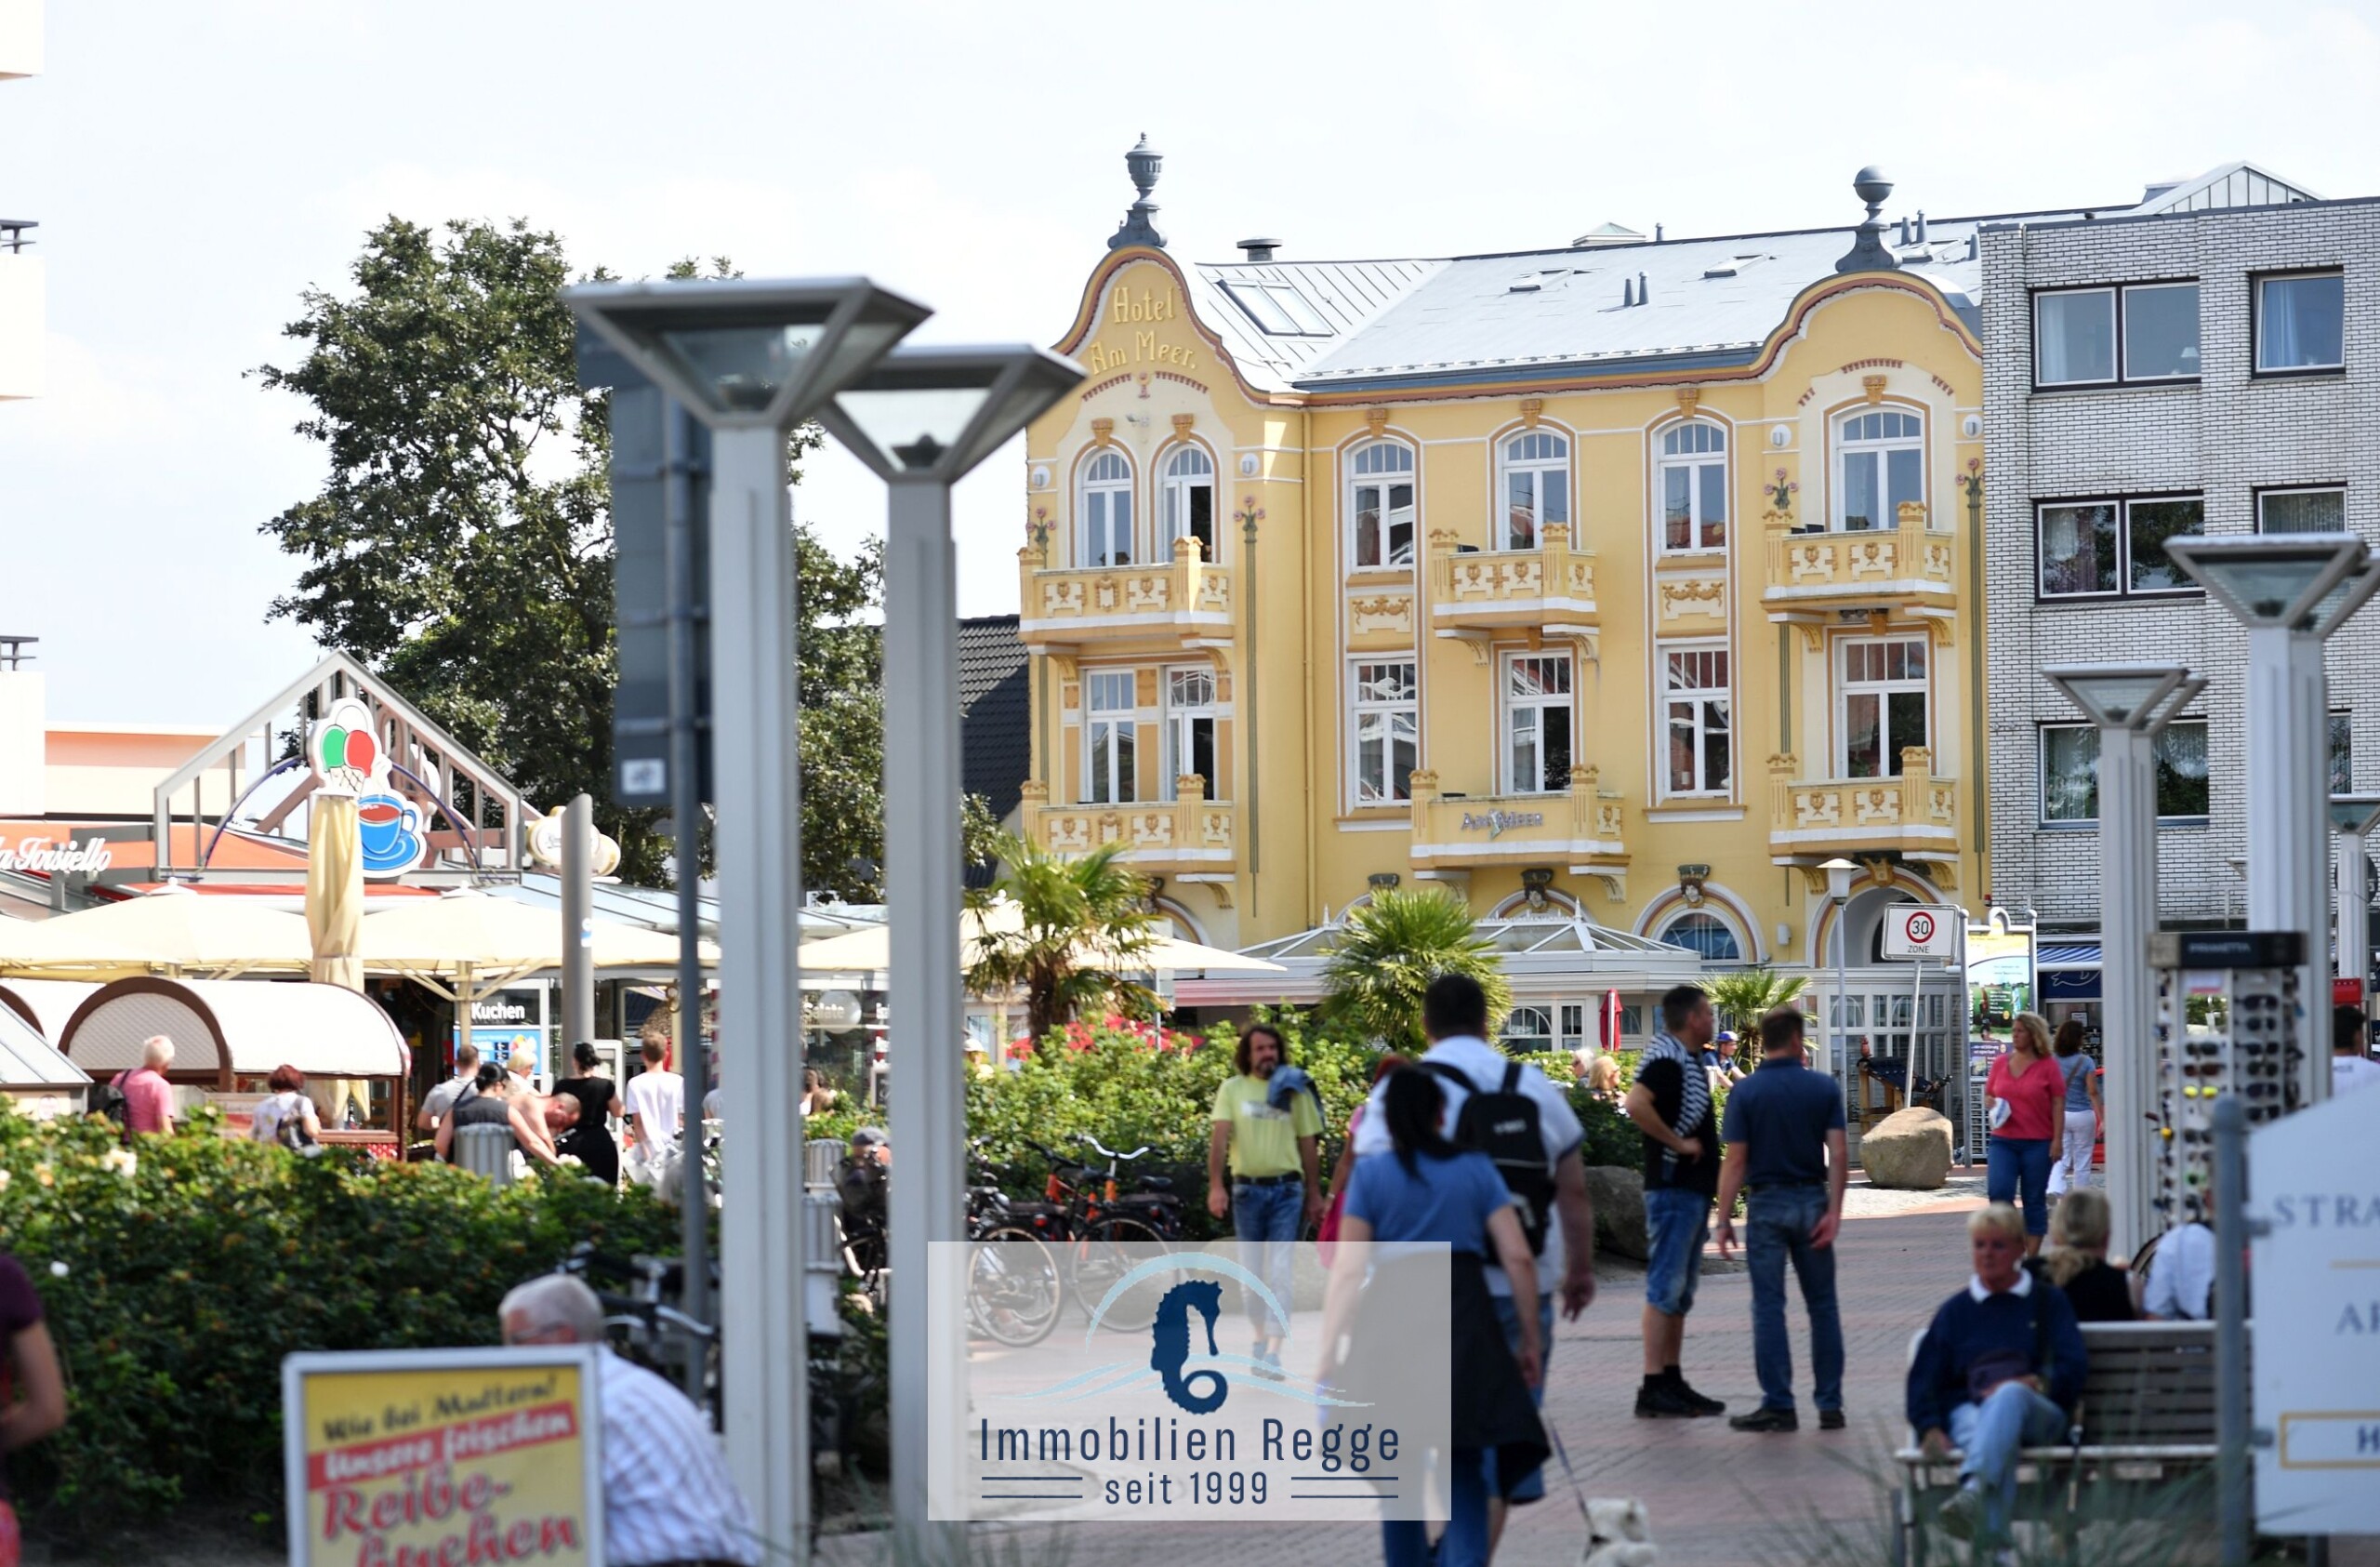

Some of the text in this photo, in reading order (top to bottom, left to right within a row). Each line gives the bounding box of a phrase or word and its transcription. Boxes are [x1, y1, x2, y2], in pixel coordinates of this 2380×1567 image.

[1113, 286, 1174, 323] Hotel
[1091, 341, 1127, 375] Am
[1911, 920, 1929, 935] 30
[1908, 945, 1930, 954] ZONE
[470, 1002, 525, 1020] Kuchen
[802, 1003, 845, 1020] Salate
[324, 1419, 374, 1441] Wie
[384, 1404, 420, 1430] bei
[324, 1410, 571, 1481] Unsere frischen
[322, 1464, 513, 1541] Reibe-
